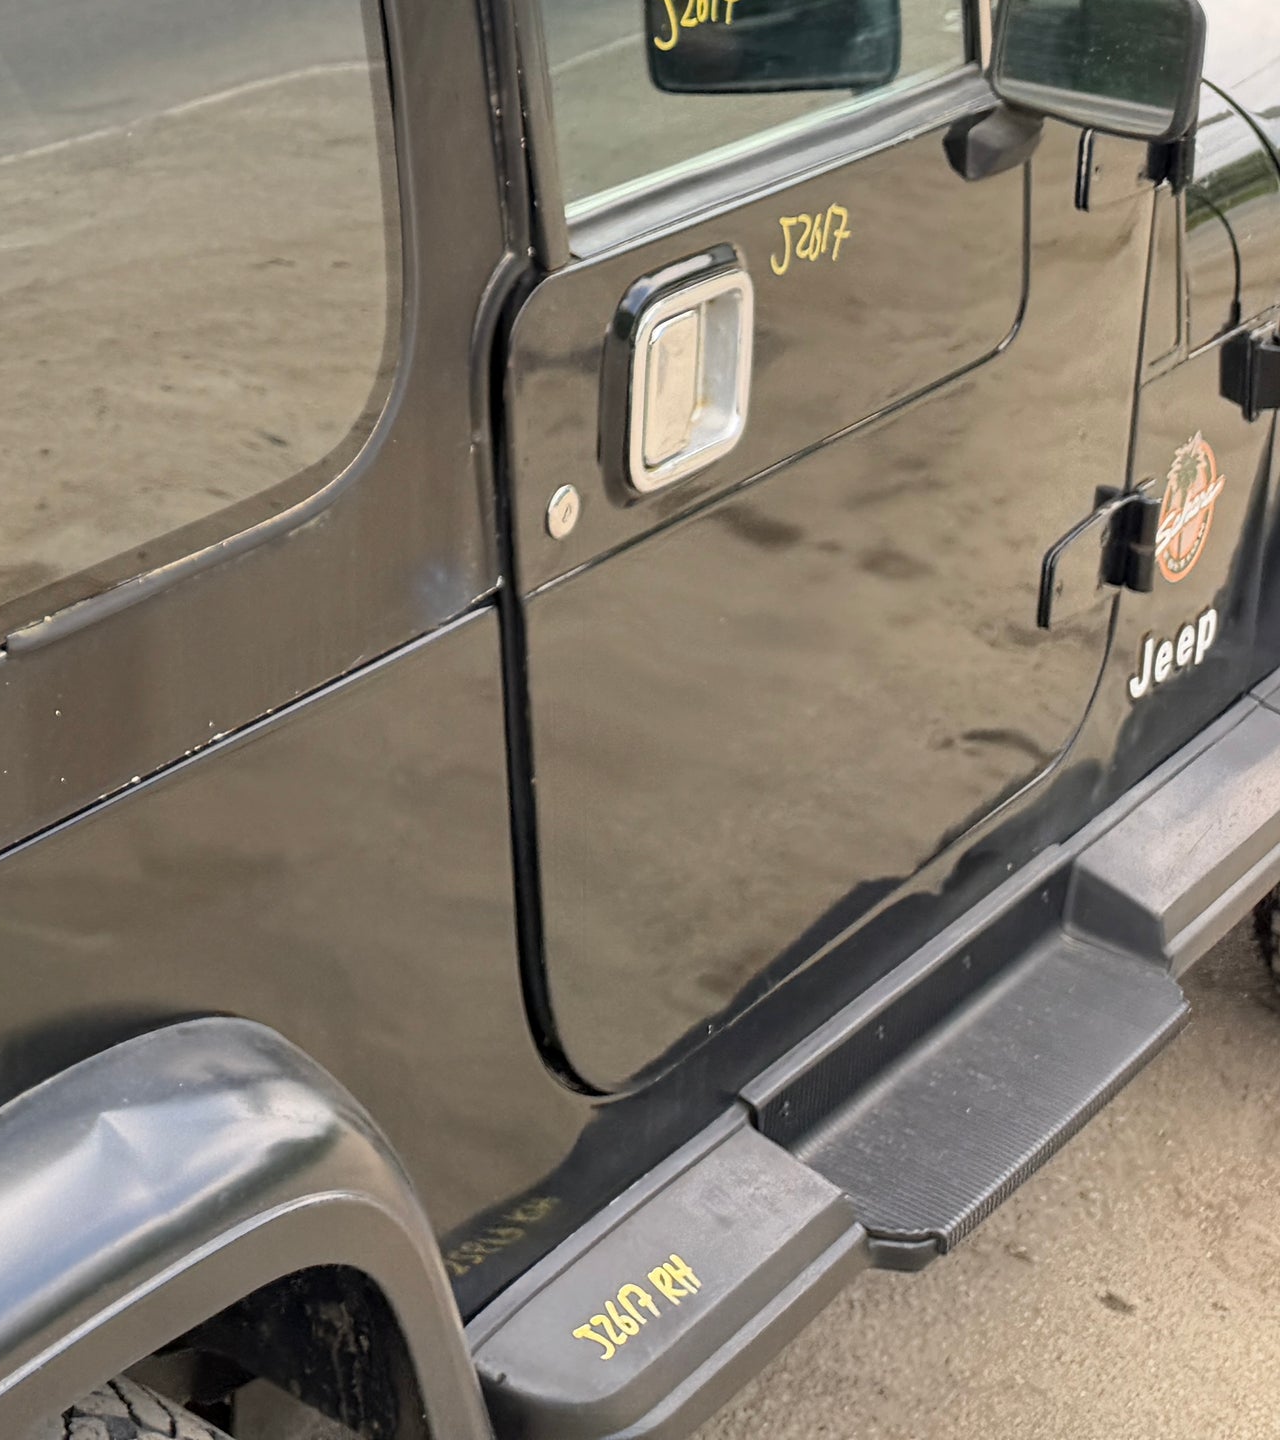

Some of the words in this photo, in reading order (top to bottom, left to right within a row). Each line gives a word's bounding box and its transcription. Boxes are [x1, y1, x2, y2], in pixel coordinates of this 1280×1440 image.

[770, 202, 851, 276] J2617
[1128, 608, 1218, 699] Jeep
[571, 1283, 662, 1361] J2617
[646, 1253, 703, 1306] RH
